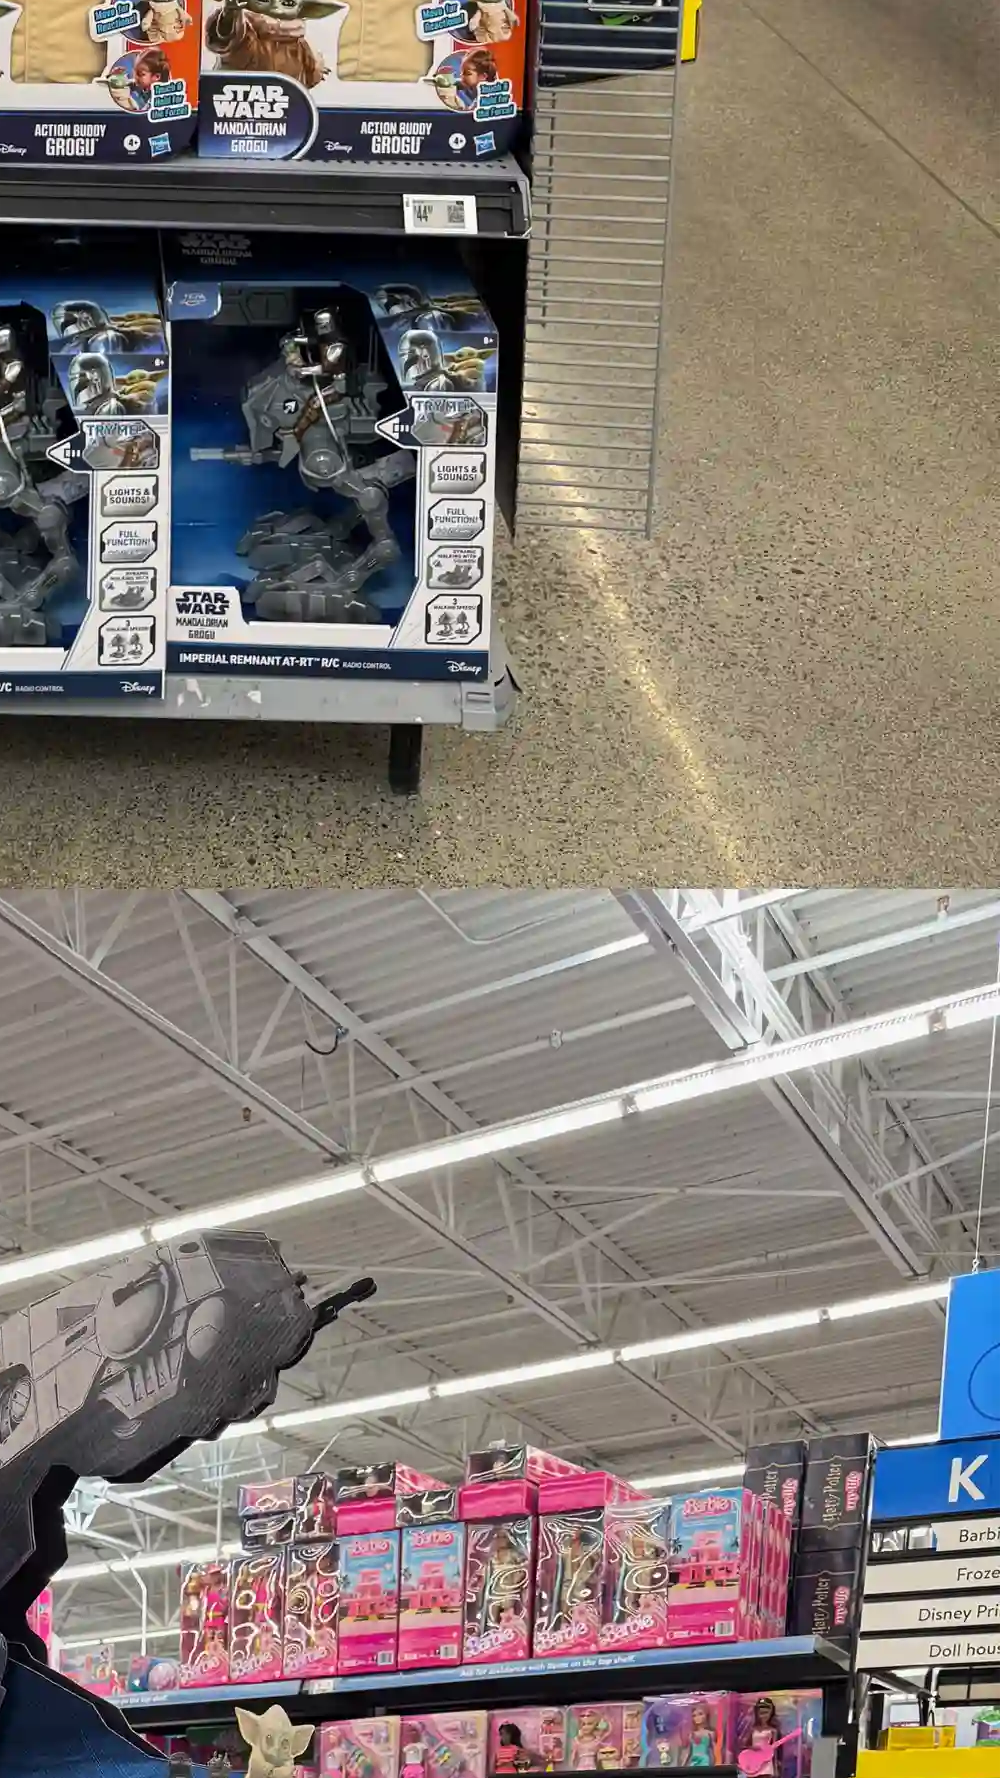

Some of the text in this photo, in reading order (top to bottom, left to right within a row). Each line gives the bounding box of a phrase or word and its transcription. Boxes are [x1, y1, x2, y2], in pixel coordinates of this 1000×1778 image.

[948, 1455, 989, 1502] K
[684, 1495, 732, 1515] Barbie
[957, 1568, 1000, 1581] Froze
[918, 1608, 972, 1623] Disney
[929, 1643, 961, 1658] Doll
